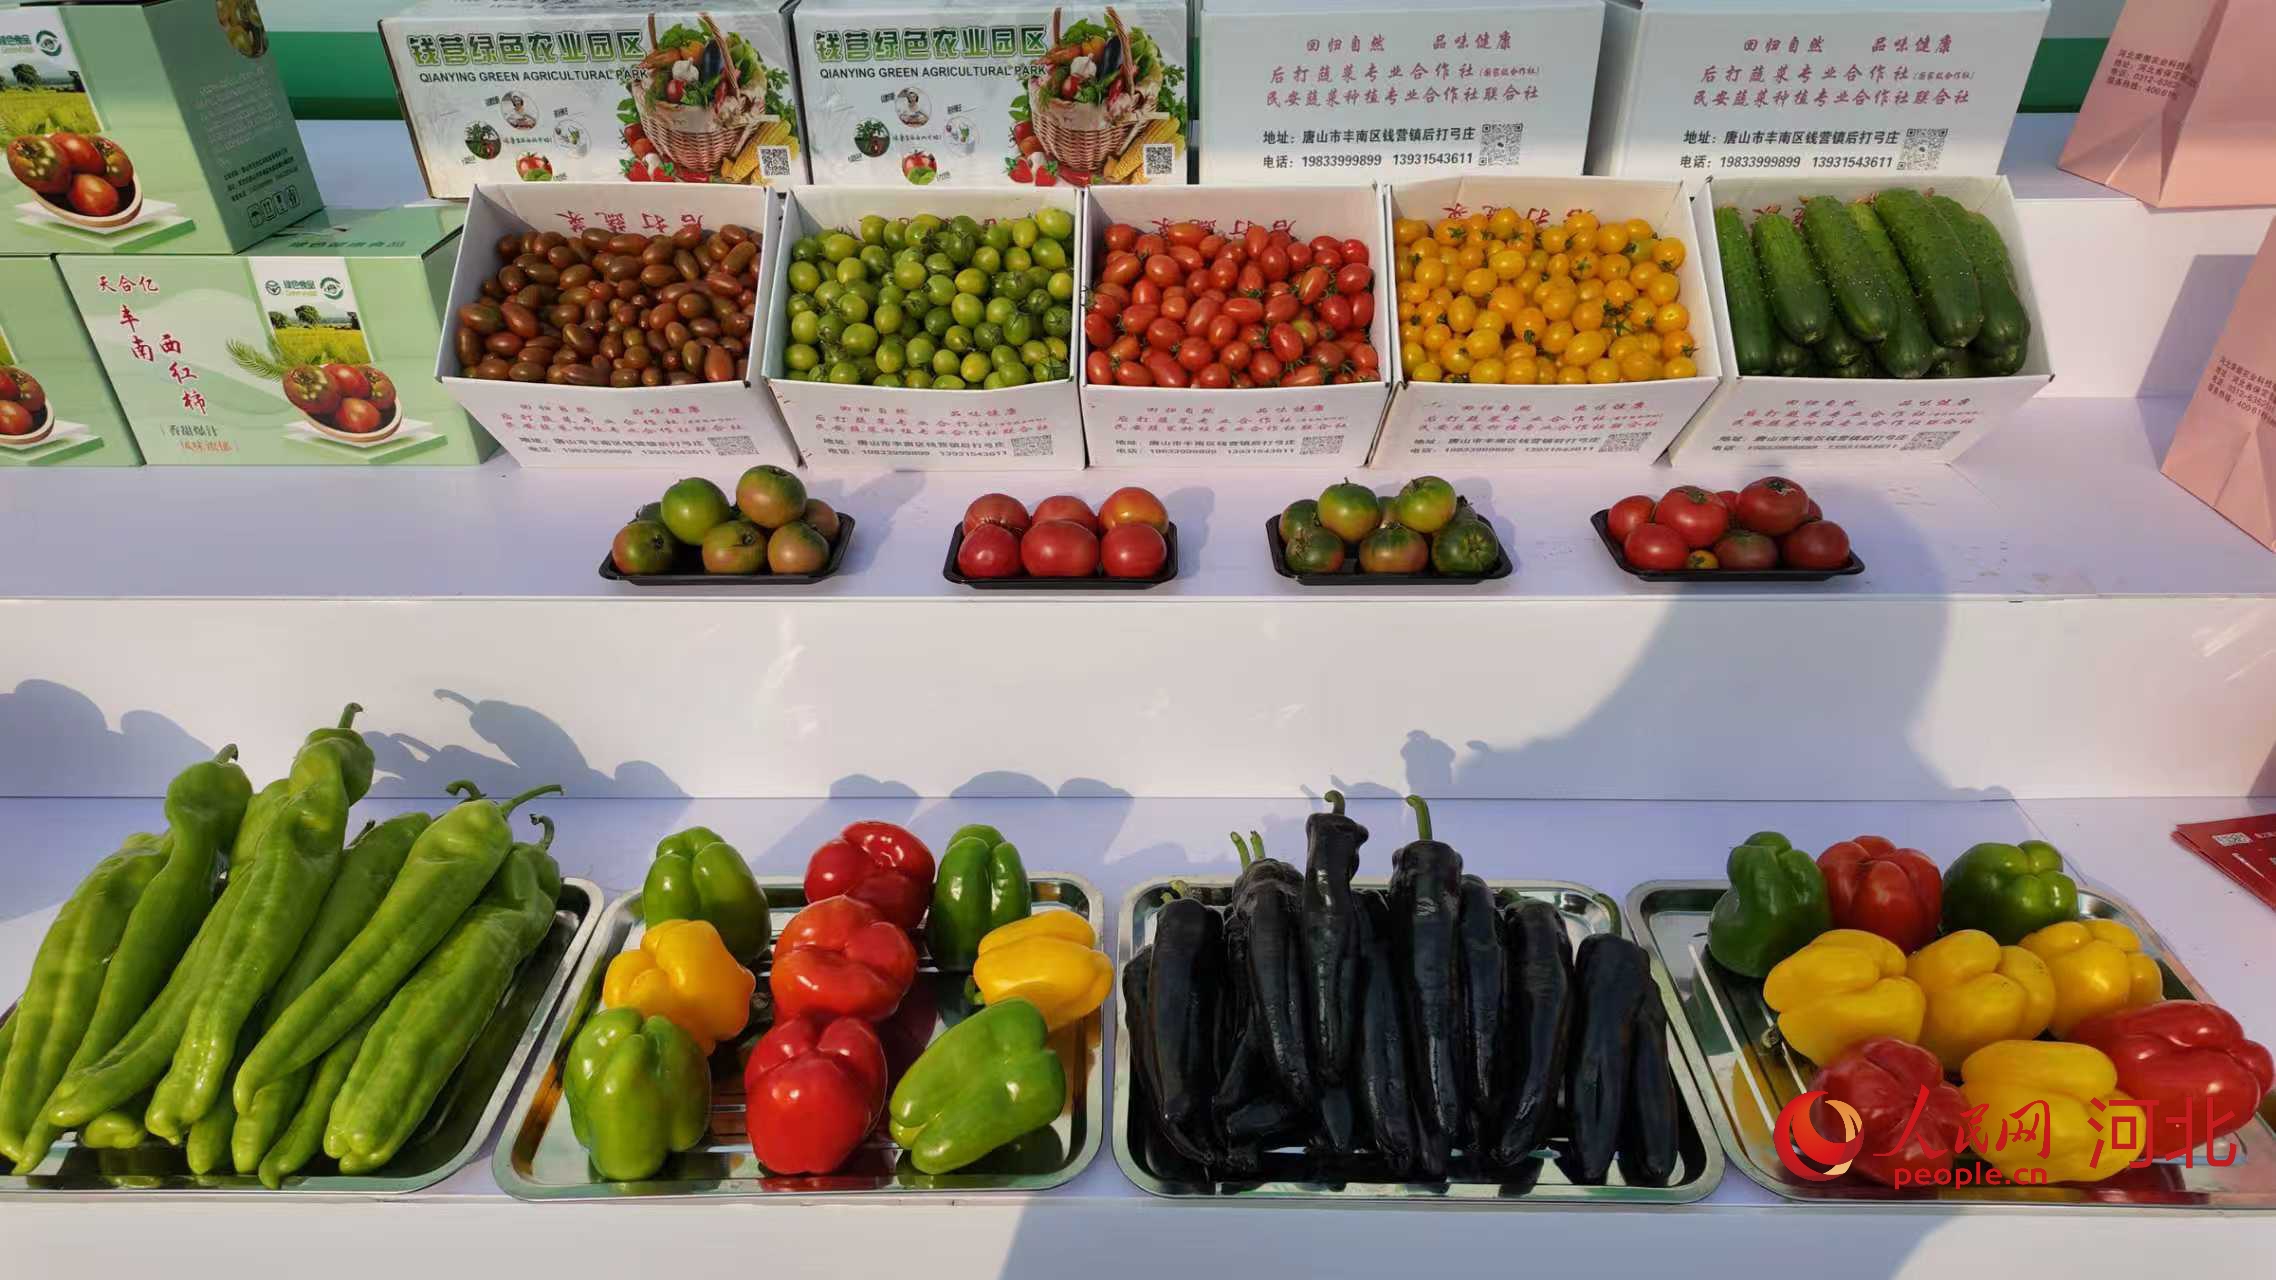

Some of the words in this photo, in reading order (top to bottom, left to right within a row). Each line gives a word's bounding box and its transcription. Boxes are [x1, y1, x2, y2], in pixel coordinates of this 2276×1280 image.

[406, 30, 648, 66] 钱营绿色农业园区
[815, 25, 1048, 62] 钱营绿色农业园区
[1306, 34, 1385, 53] 回归自然
[1432, 30, 1512, 51] 品味健康
[1744, 36, 1825, 53] 回归自然
[1871, 34, 1953, 53] 品味健康
[419, 71, 476, 83] QIANYING
[479, 70, 519, 82] GREEN
[523, 70, 611, 81] AGRICULTURAL
[616, 68, 648, 80] PARK
[820, 67, 876, 79] QIANYING
[878, 66, 919, 78] GREEN
[922, 65, 1011, 77] AGRICULTURAL
[1015, 64, 1047, 75] PARK
[1266, 84, 1540, 108] 民安蔬菜种植专业合作社联合社
[1693, 87, 1970, 107] 民安蔬菜种植专业合作社联合社
[1392, 152, 1473, 166] 13931543611
[1812, 156, 1893, 168] 13931543611
[98, 274, 159, 293] 天合亿
[120, 304, 154, 362] 丰南
[160, 333, 206, 415] 西红柿
